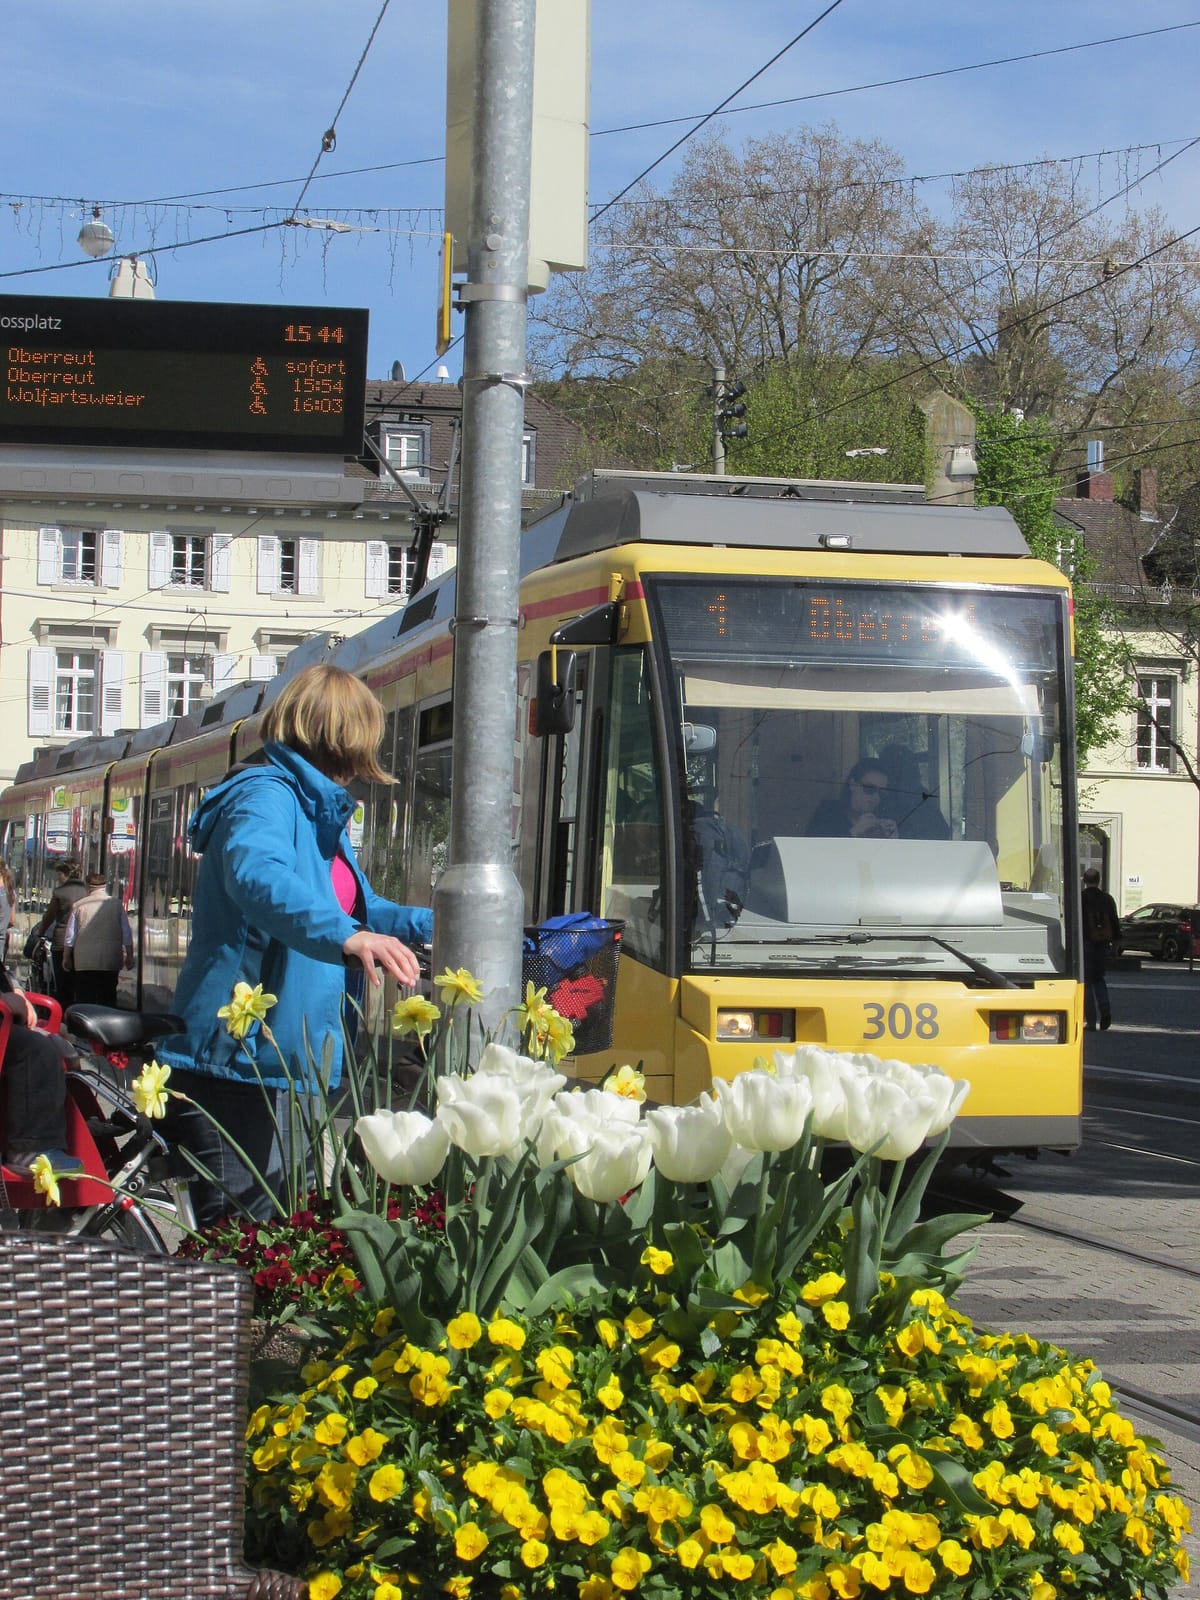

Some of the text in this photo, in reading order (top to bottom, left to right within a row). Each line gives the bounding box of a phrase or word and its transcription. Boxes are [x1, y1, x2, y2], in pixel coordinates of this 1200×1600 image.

[7, 347, 96, 366] Oberreut
[7, 367, 95, 385] Oberreut
[284, 359, 346, 377] sofort
[293, 378, 344, 394] 15:54
[7, 386, 145, 407] Wolfartsweier
[292, 397, 343, 413] 16:03
[708, 594, 726, 635] 1
[862, 1002, 940, 1040] 308
